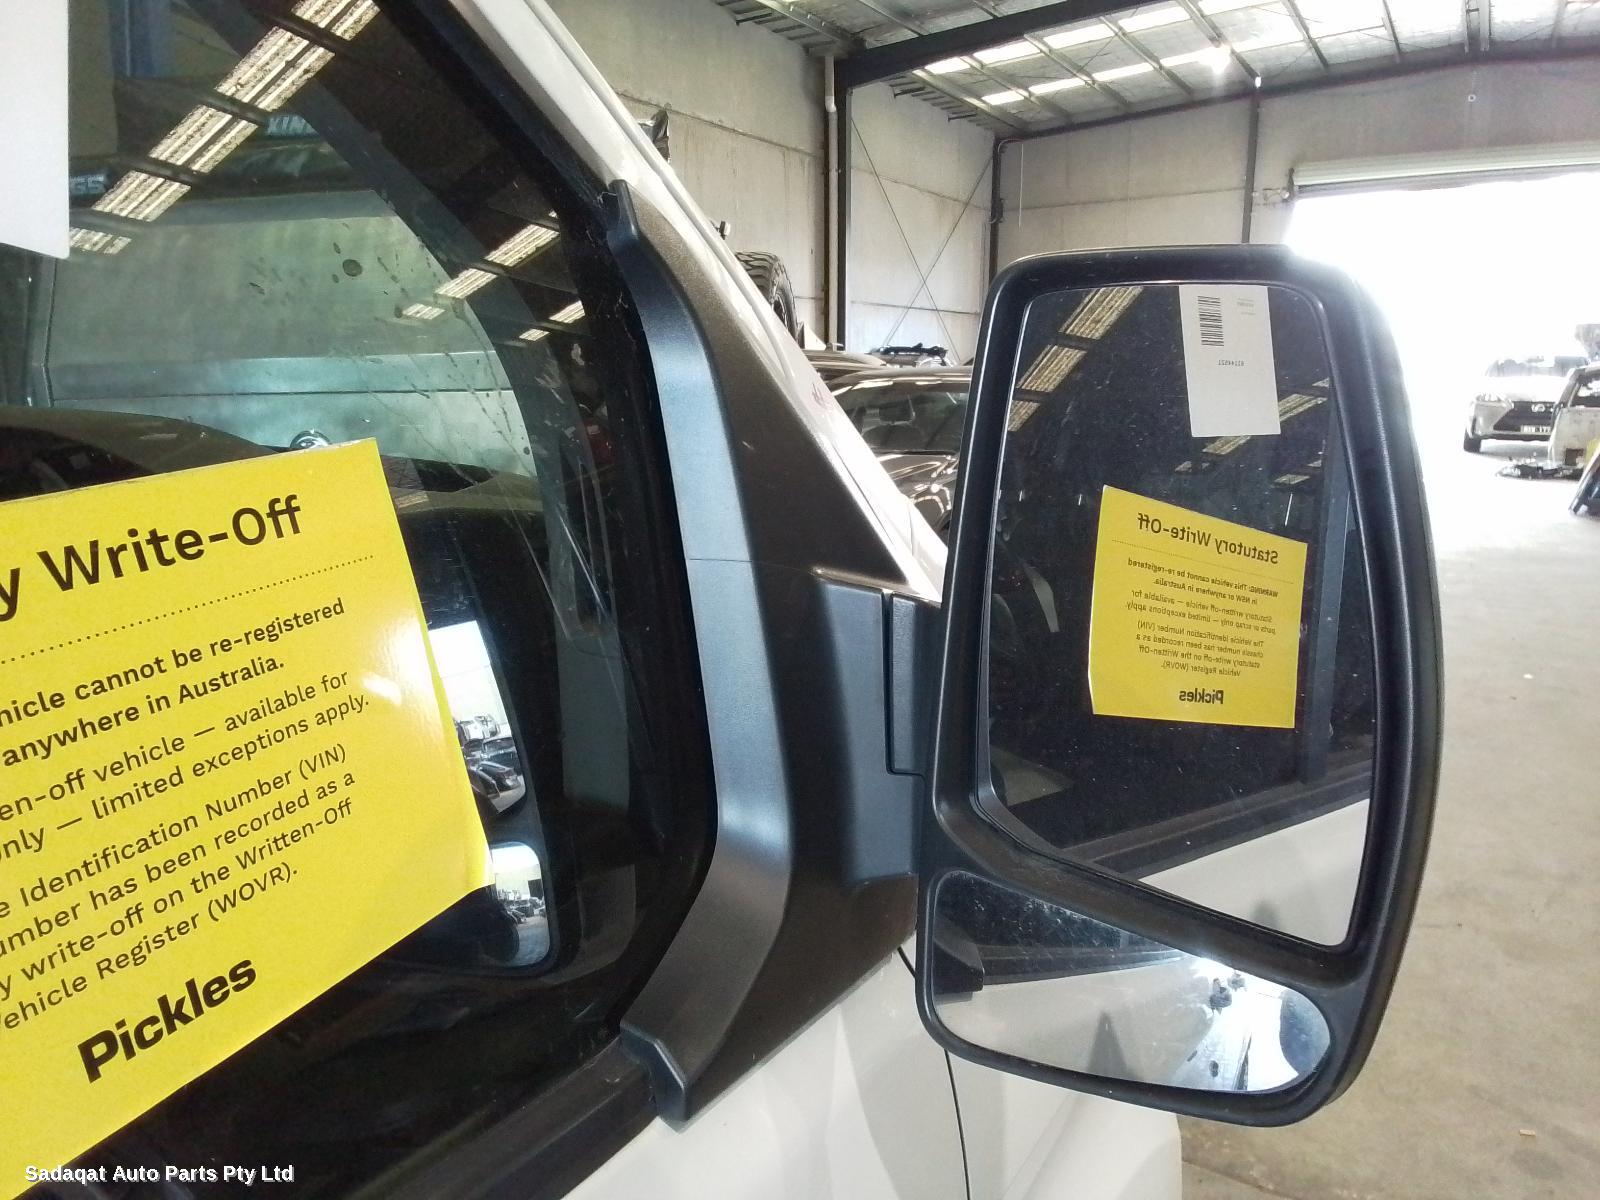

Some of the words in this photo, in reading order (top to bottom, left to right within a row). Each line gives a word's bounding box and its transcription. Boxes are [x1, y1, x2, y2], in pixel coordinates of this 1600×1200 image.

[37, 495, 302, 592] Write-Off
[75, 656, 167, 700] cannot
[171, 648, 203, 668] be
[210, 597, 345, 656] re-registered
[2, 706, 140, 767] anywhere
[145, 694, 171, 714] in
[179, 656, 284, 704] Australia.
[93, 736, 185, 782] vehicle
[225, 685, 316, 732] available
[321, 672, 348, 693] for
[0, 827, 44, 860] nly
[91, 765, 184, 820] limited
[192, 718, 309, 777] exceptions
[315, 695, 369, 726] apply.
[20, 814, 199, 907] Identification
[205, 770, 292, 821] Number
[299, 743, 346, 780] (VIN)
[21, 902, 145, 981] write-off
[153, 889, 185, 914] on
[190, 865, 230, 894] the
[235, 797, 352, 870] Written-Off
[89, 877, 138, 911] has
[144, 844, 207, 883] been
[214, 789, 310, 850] recorded
[315, 780, 338, 800] as
[343, 772, 356, 787] a
[96, 912, 200, 980] Register
[208, 862, 298, 922] (WOVR).
[77, 959, 256, 1084] Pickles
